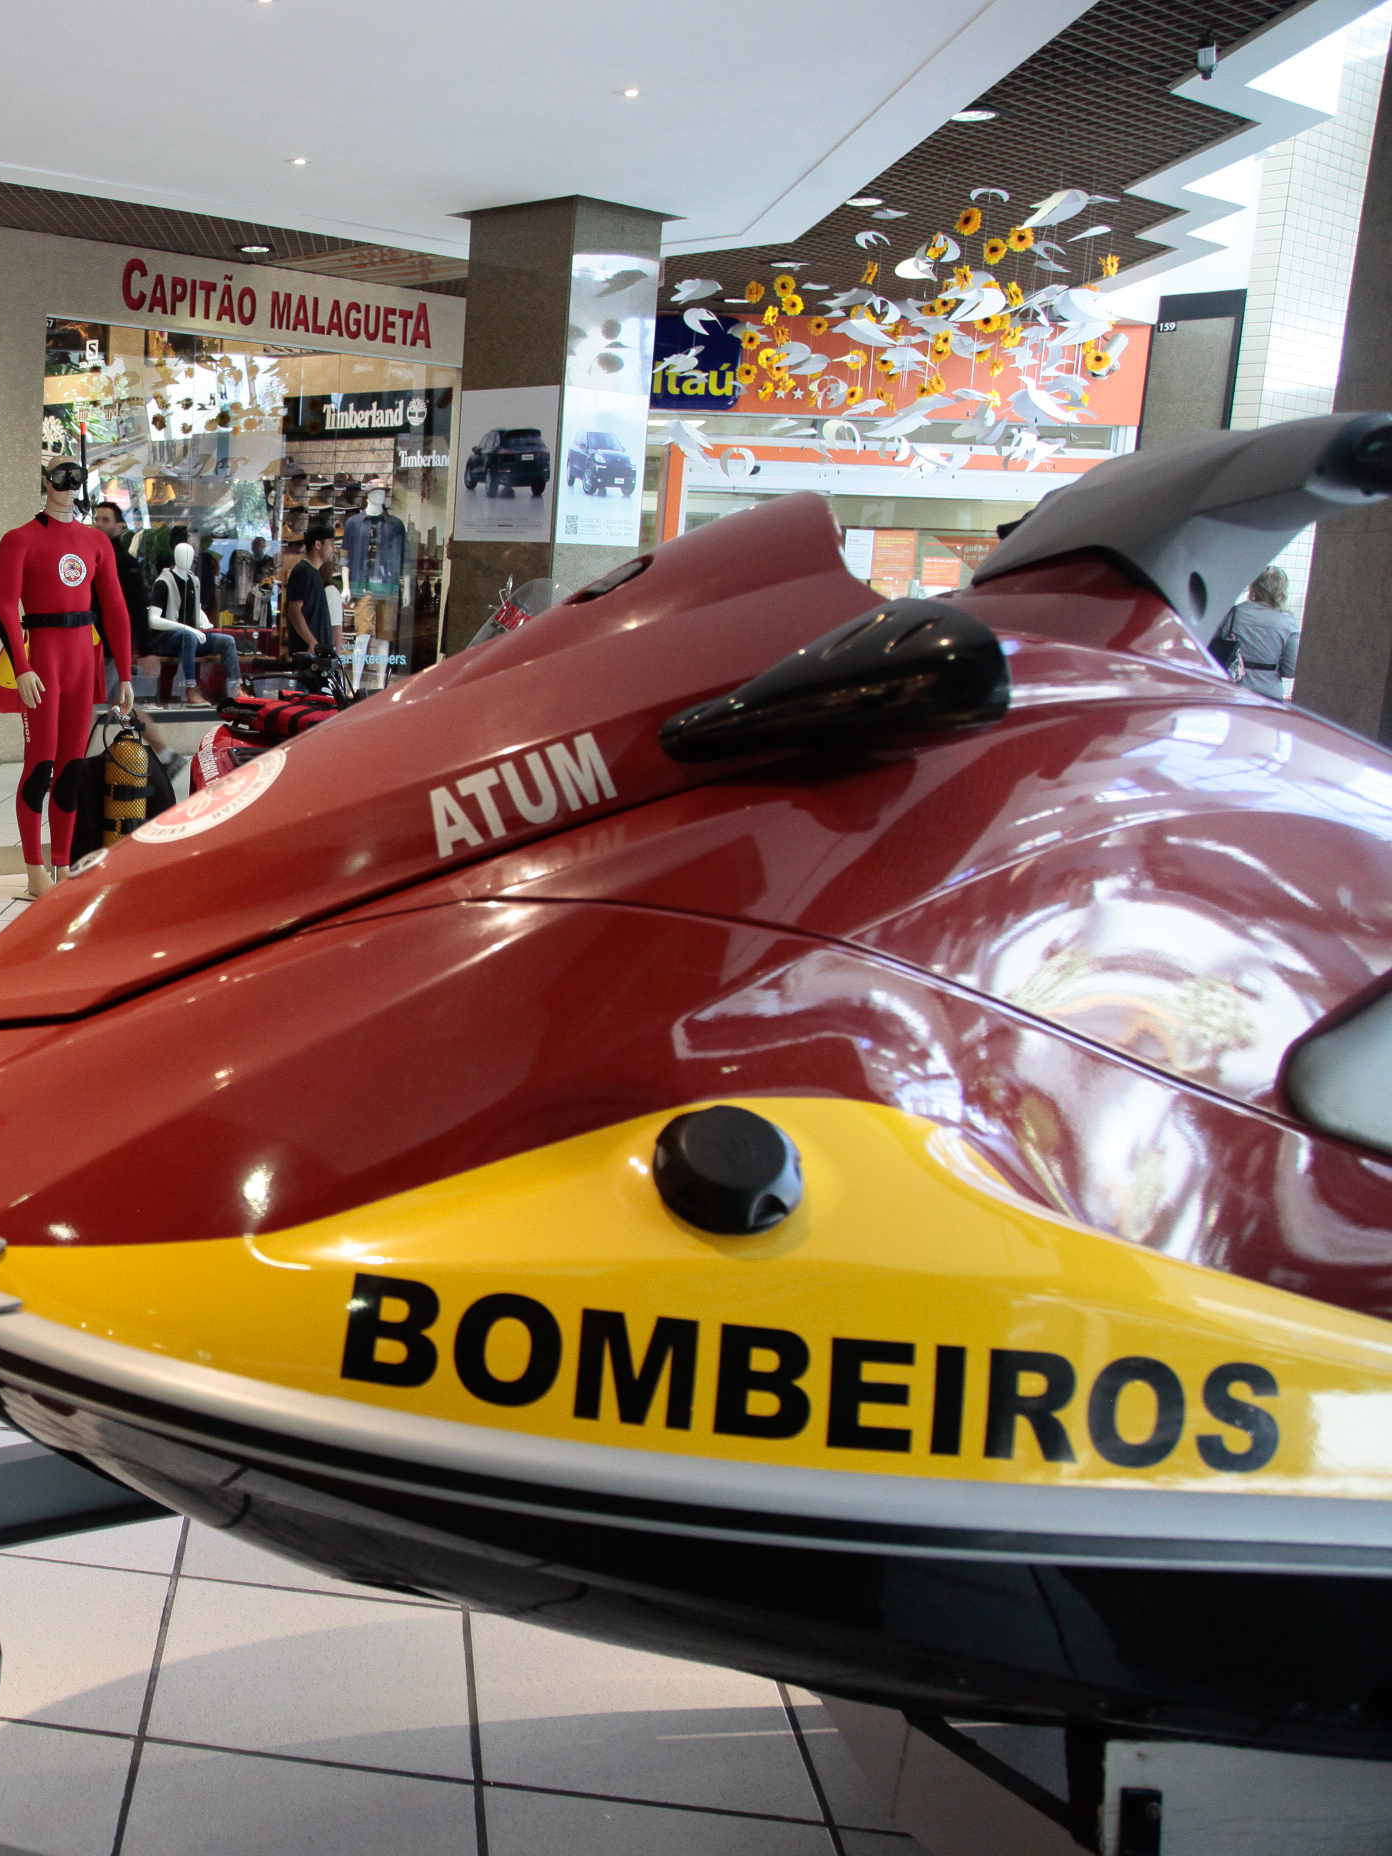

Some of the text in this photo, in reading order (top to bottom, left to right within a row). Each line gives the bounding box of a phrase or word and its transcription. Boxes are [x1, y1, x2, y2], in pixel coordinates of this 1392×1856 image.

[122, 258, 432, 349] CAPITÃO MALAGUETA
[1159, 321, 1176, 332] 159
[652, 361, 735, 397] Itaú
[323, 399, 404, 430] Timberland
[429, 731, 618, 860] ATUM
[339, 1271, 1282, 1475] BOMBEIROS
